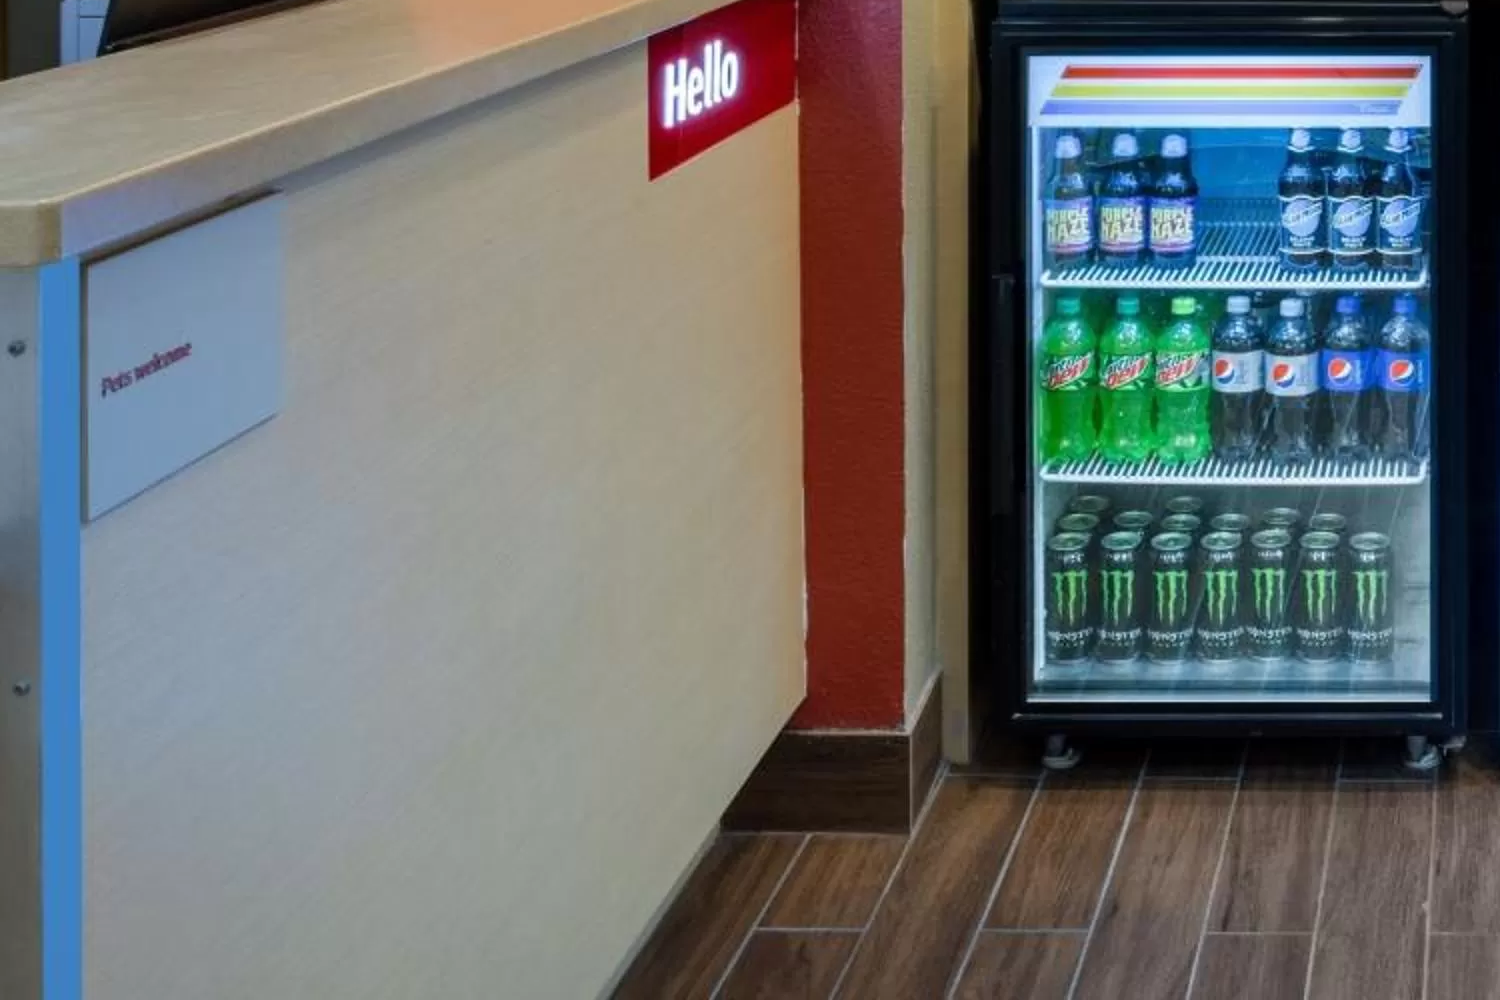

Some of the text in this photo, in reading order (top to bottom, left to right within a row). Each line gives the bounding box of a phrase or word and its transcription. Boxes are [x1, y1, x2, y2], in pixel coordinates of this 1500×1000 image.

[662, 38, 740, 130] Hello
[101, 342, 192, 399] Pets welcome
